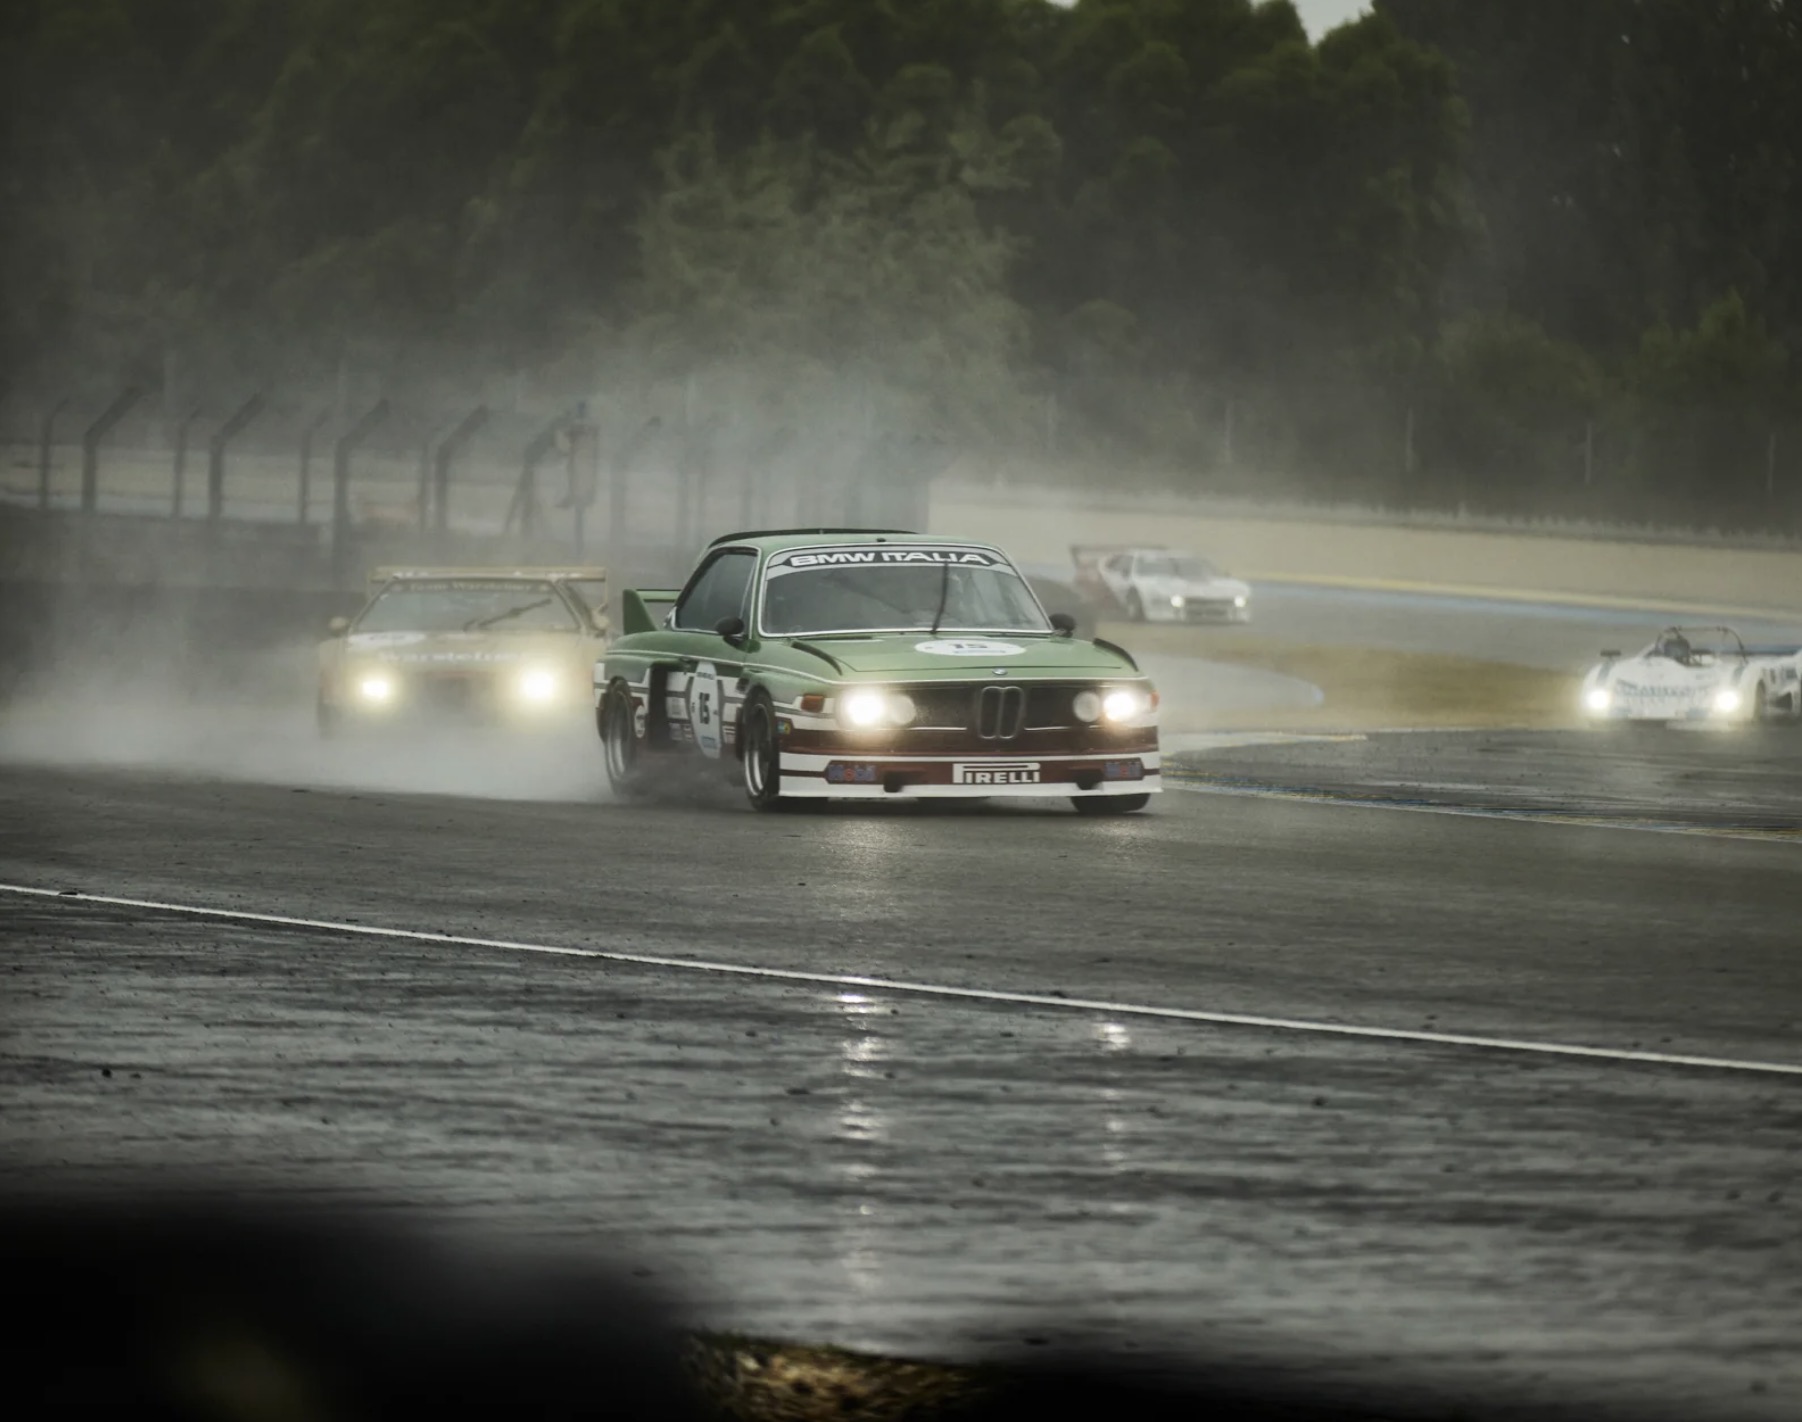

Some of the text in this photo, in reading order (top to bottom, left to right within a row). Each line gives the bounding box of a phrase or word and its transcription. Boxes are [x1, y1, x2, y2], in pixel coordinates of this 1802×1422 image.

[790, 551, 991, 566] BMW ITALIA
[698, 691, 710, 725] 15
[827, 763, 877, 782] Mobil
[952, 761, 1040, 784] PIRELLI
